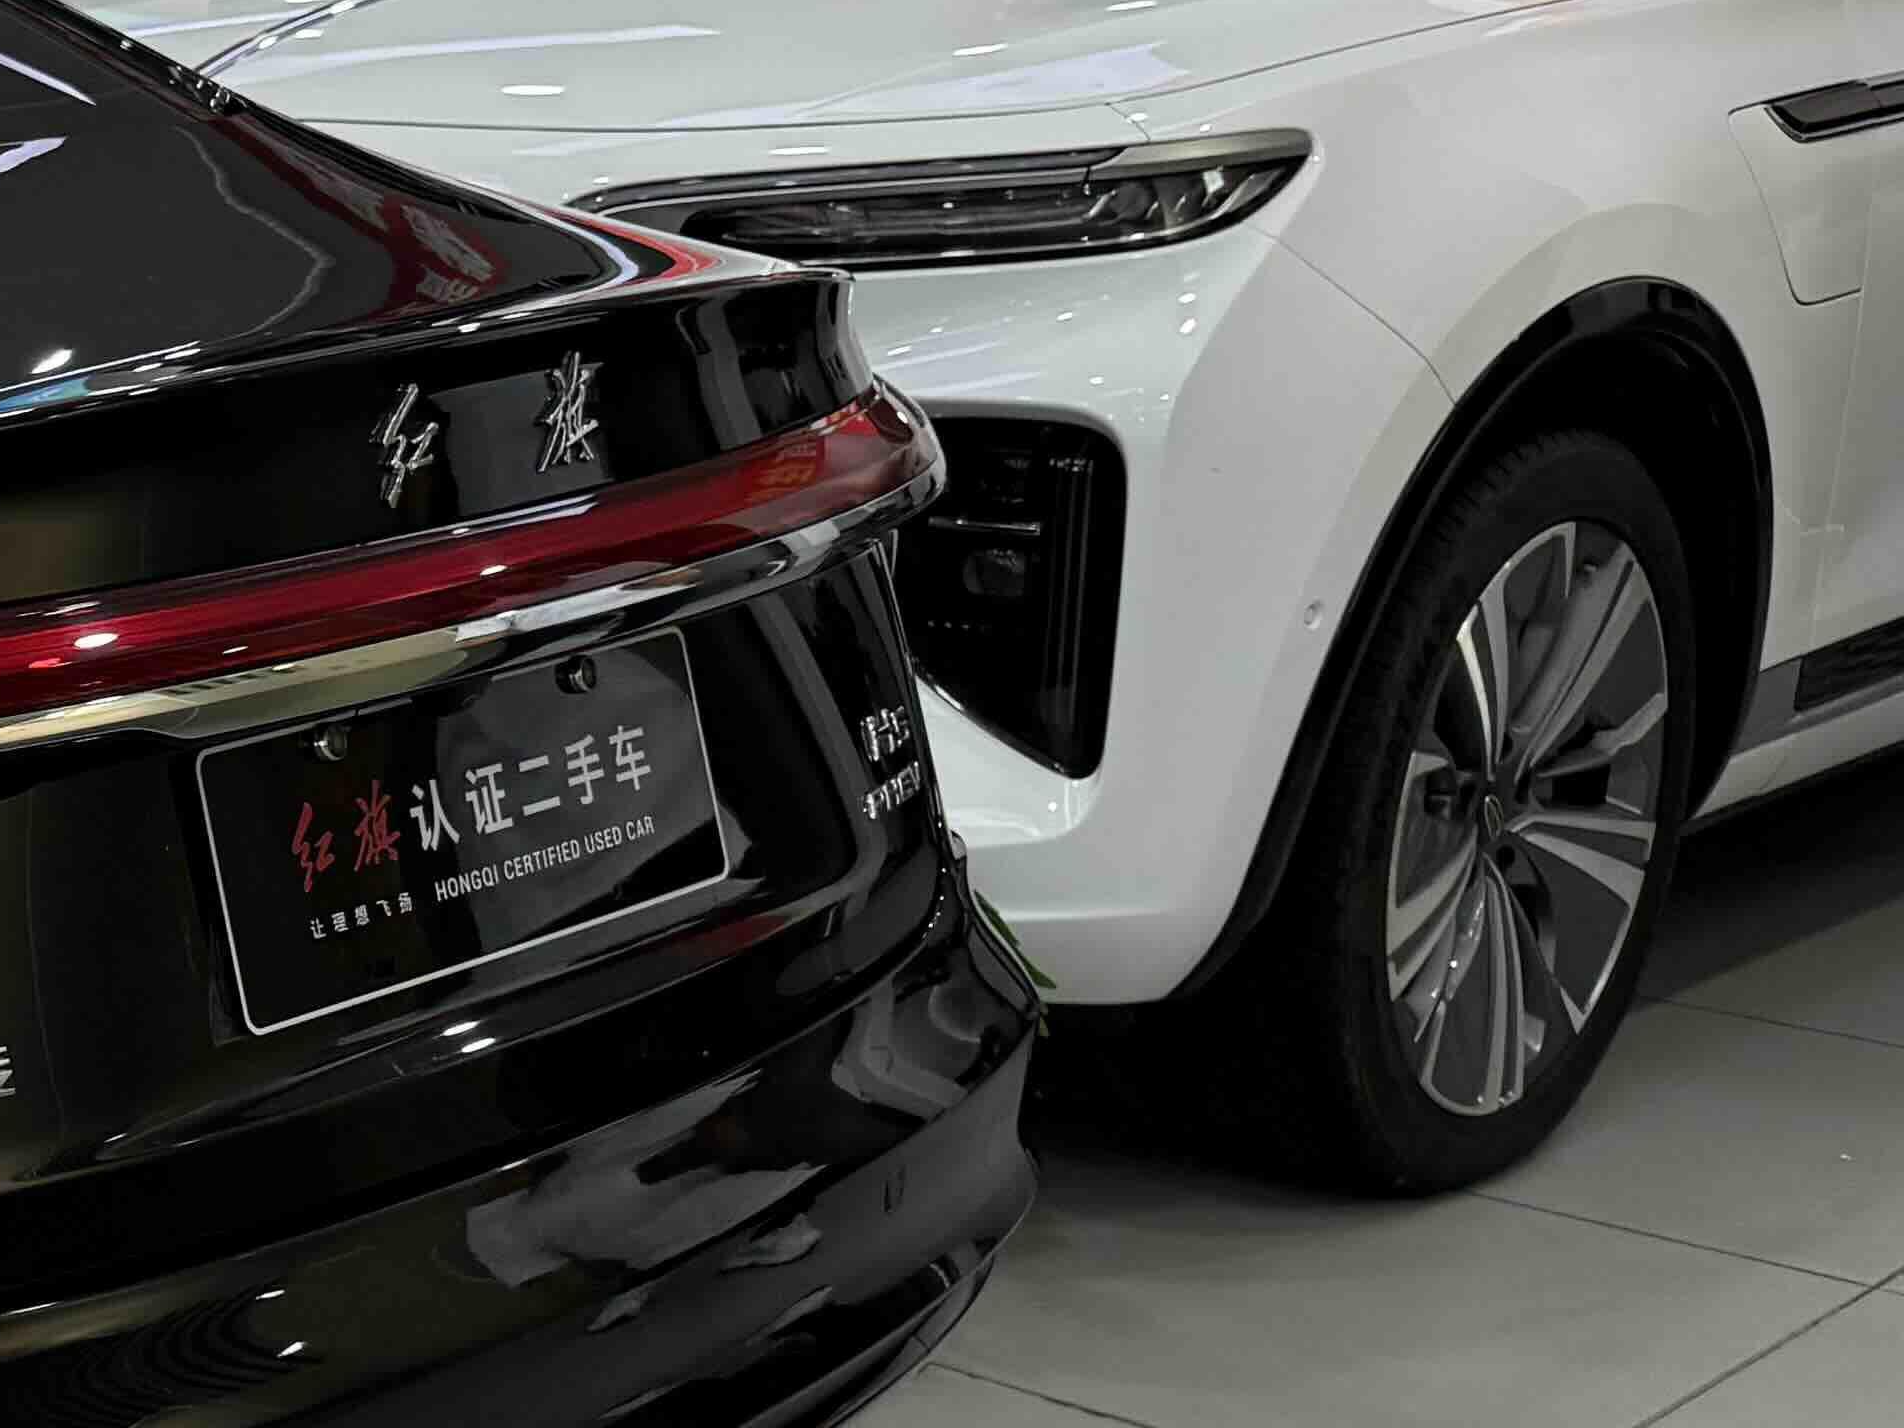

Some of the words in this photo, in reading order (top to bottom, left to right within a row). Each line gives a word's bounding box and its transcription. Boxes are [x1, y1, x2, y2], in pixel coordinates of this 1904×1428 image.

[370, 349, 604, 509] 红旗
[434, 863, 501, 903] HONGQI
[503, 838, 581, 881] CERTIFIED
[584, 825, 623, 855] USED
[625, 815, 656, 841] CAR
